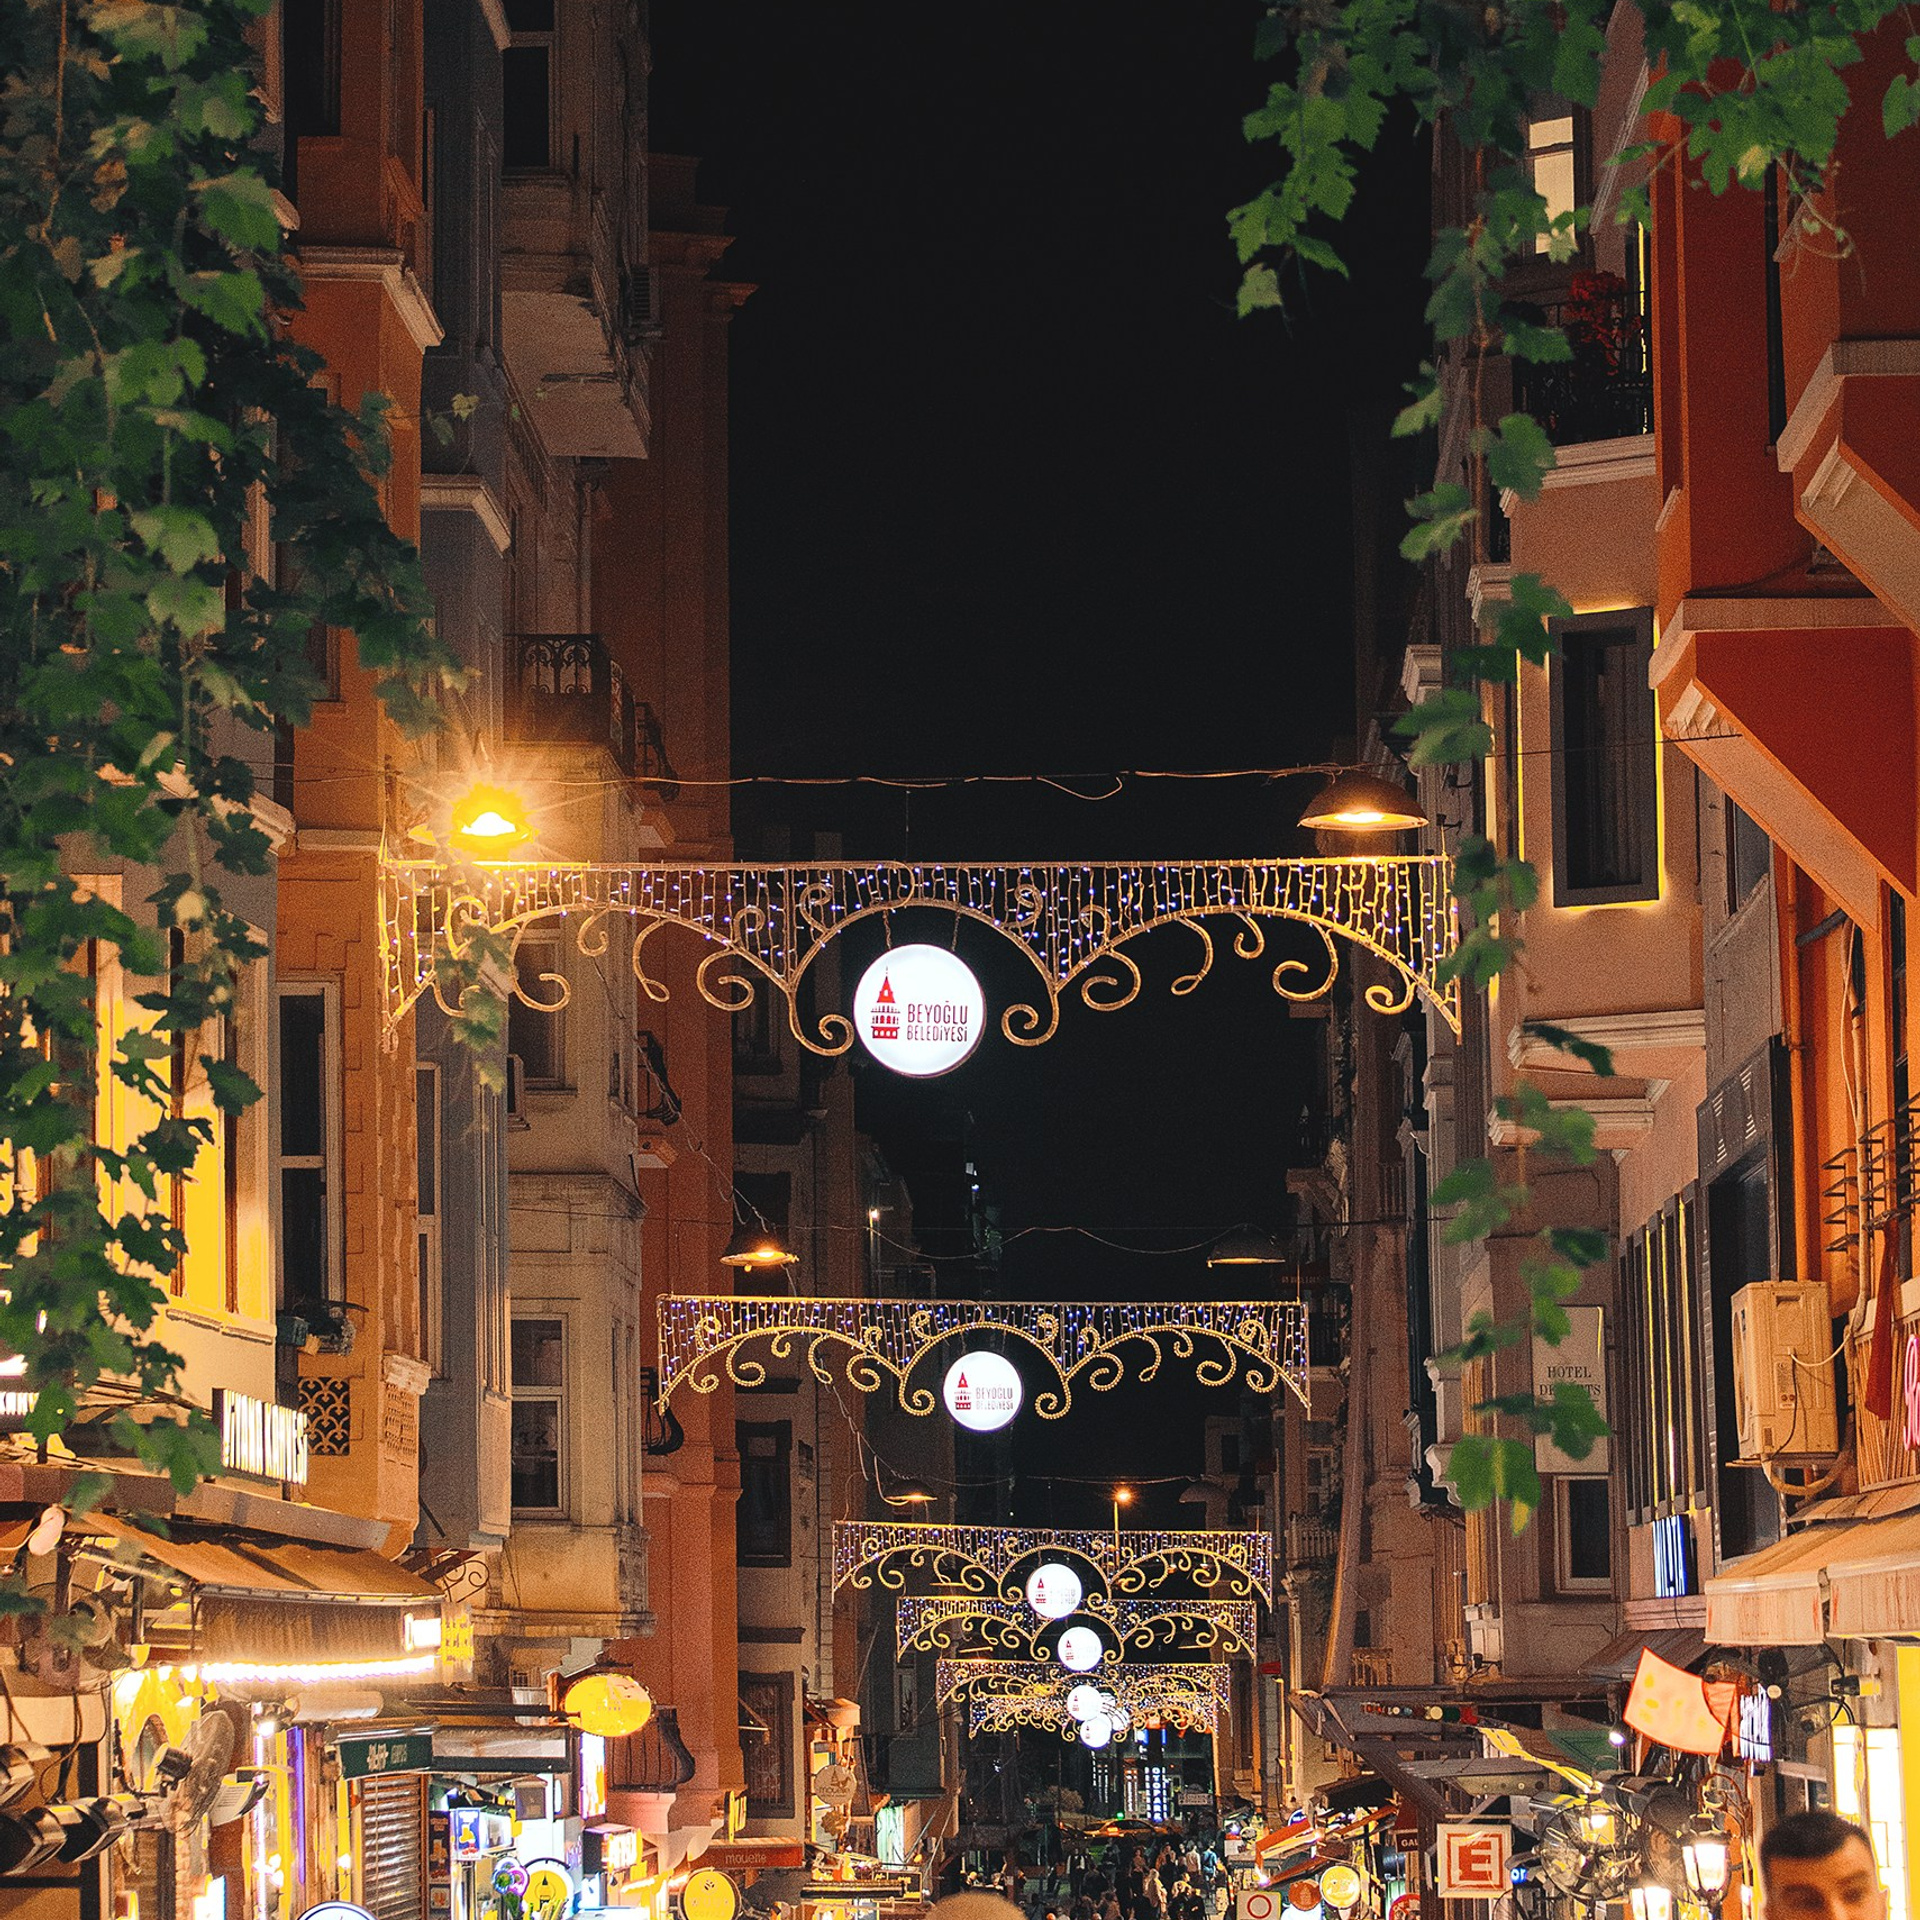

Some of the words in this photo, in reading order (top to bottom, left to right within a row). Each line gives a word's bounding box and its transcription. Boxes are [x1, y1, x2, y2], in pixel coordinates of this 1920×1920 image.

[907, 1000, 969, 1026] BEYOĞLU
[1546, 1364, 1592, 1378] HOTEL
[1458, 1840, 1493, 1882] E
